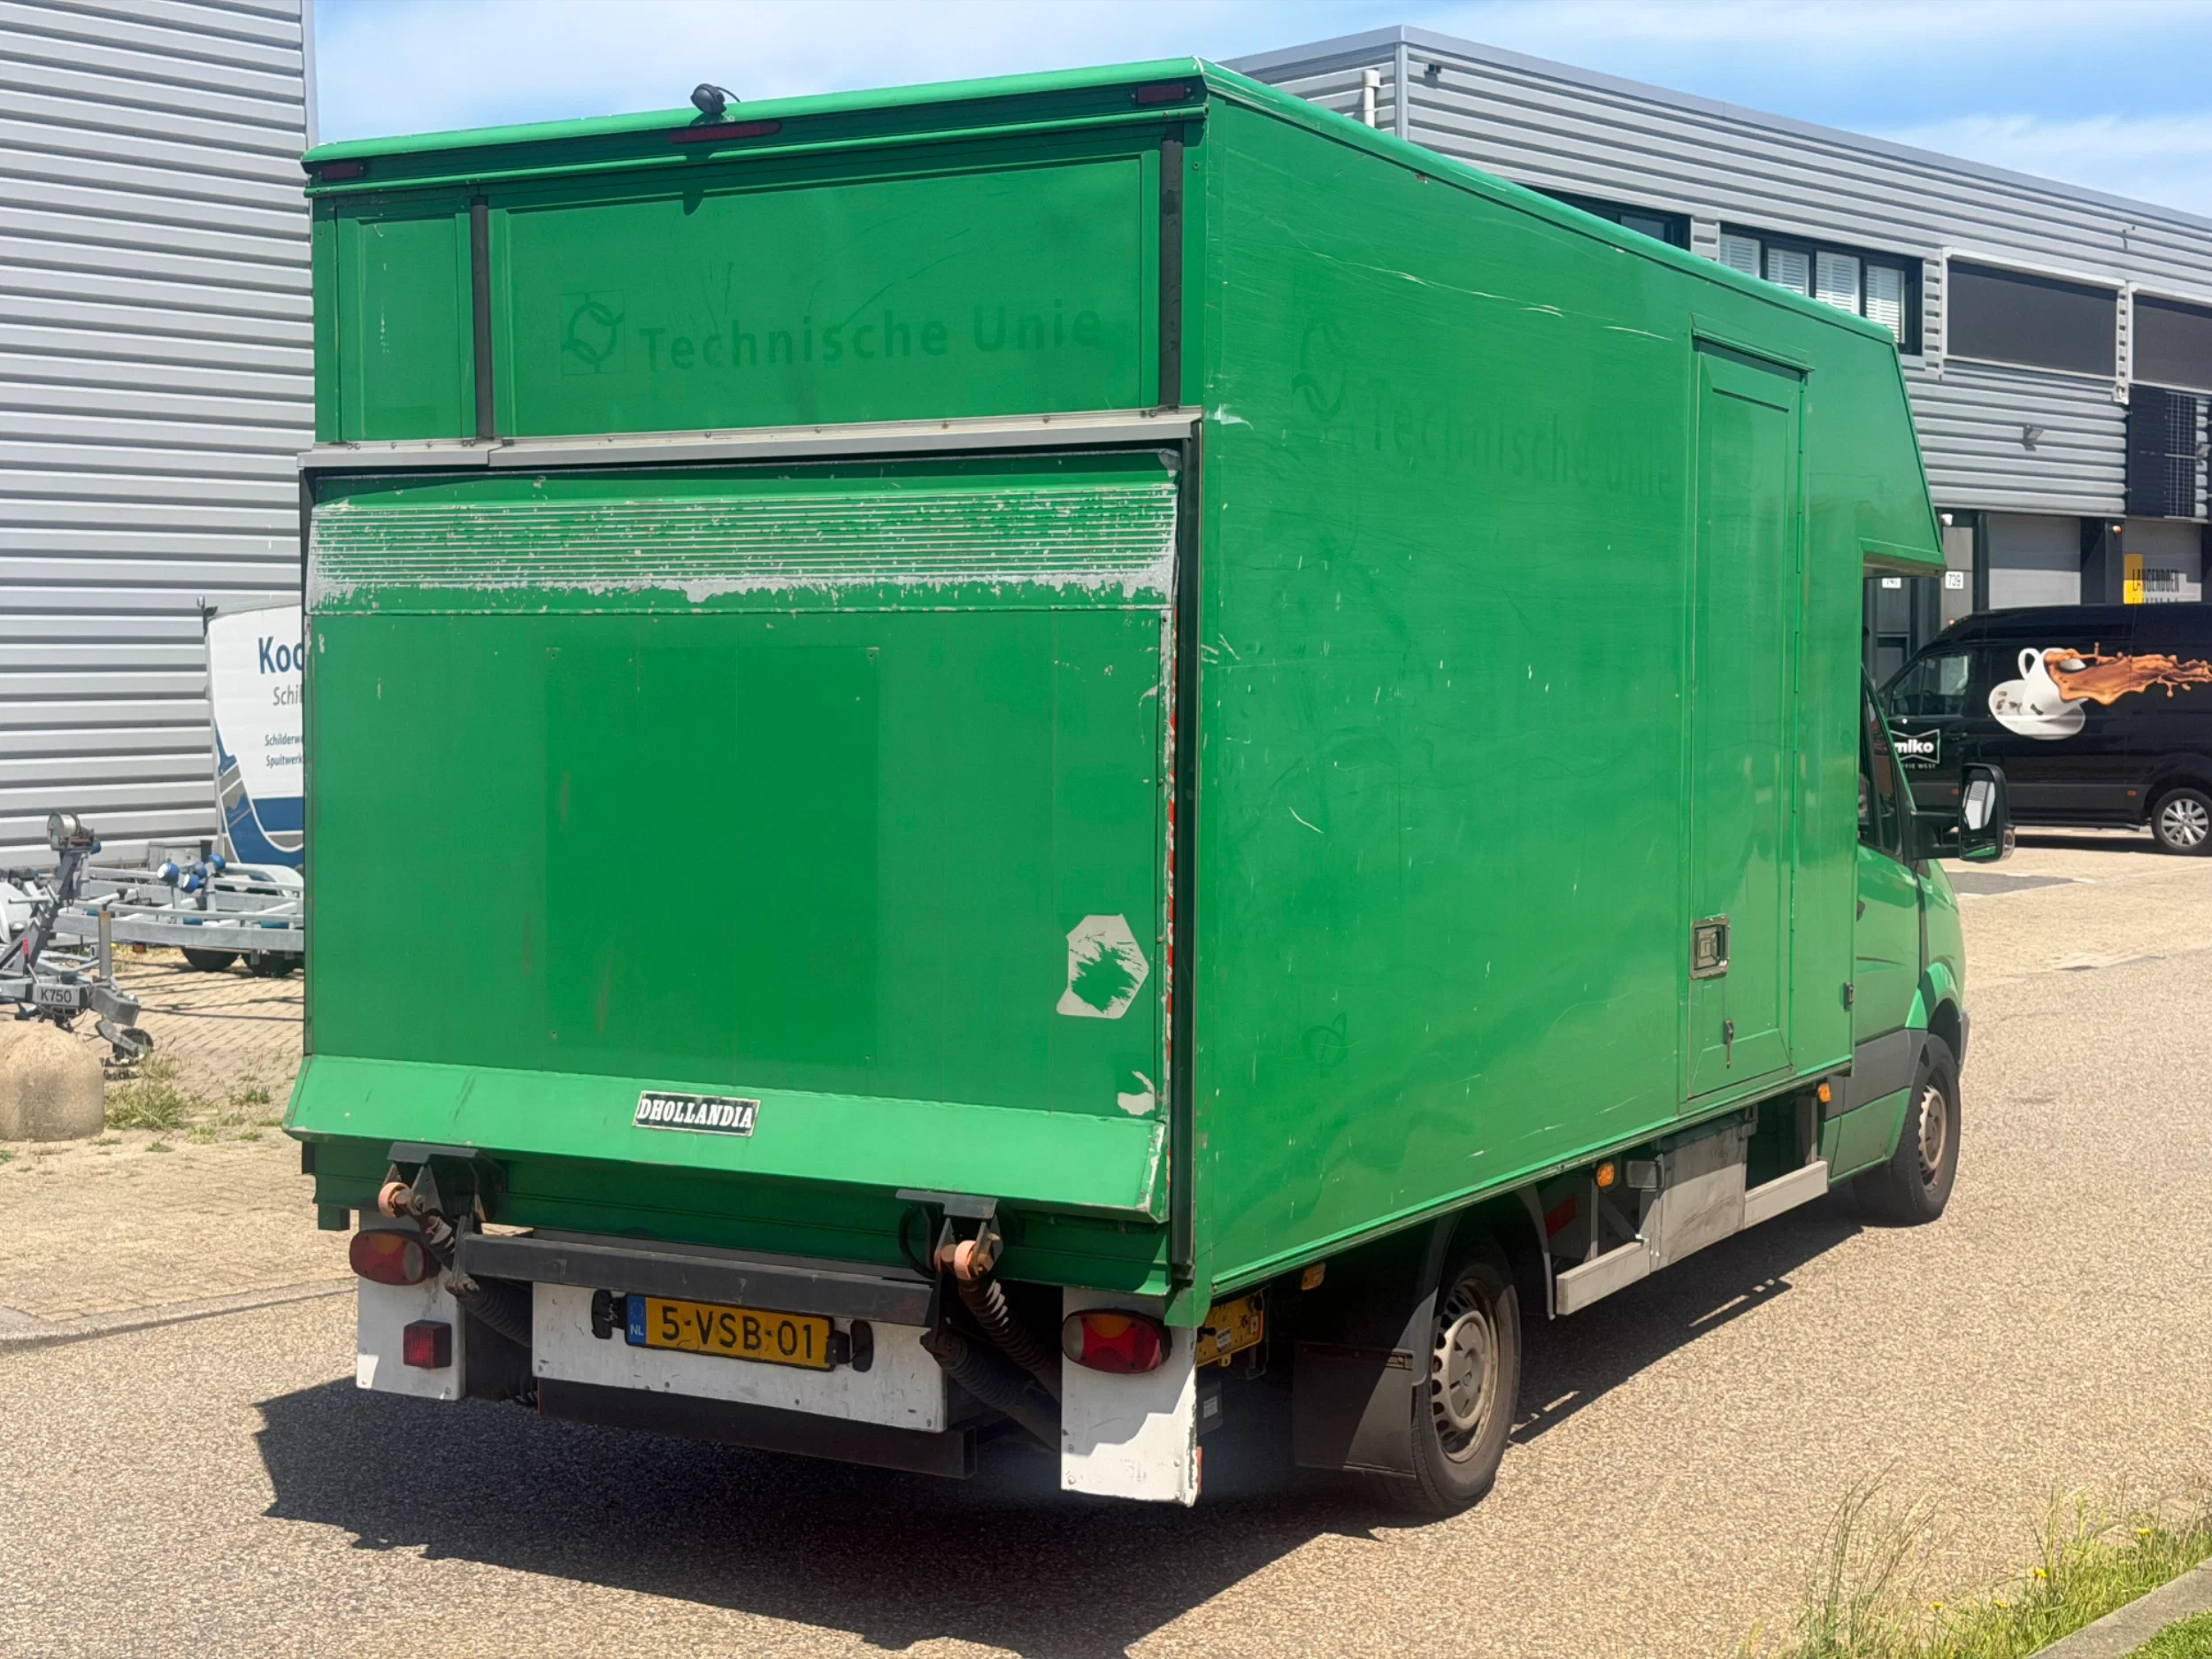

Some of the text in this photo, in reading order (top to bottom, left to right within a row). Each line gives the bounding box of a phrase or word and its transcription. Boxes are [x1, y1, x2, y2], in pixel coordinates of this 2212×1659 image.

[639, 298, 1102, 373] Technische Unie
[1948, 573, 1961, 587] 739
[41, 987, 72, 1002] K750
[637, 1099, 753, 1128] DHOLLANDIA
[630, 1324, 644, 1337] NL
[661, 1305, 812, 1359] 5-VSB-01
